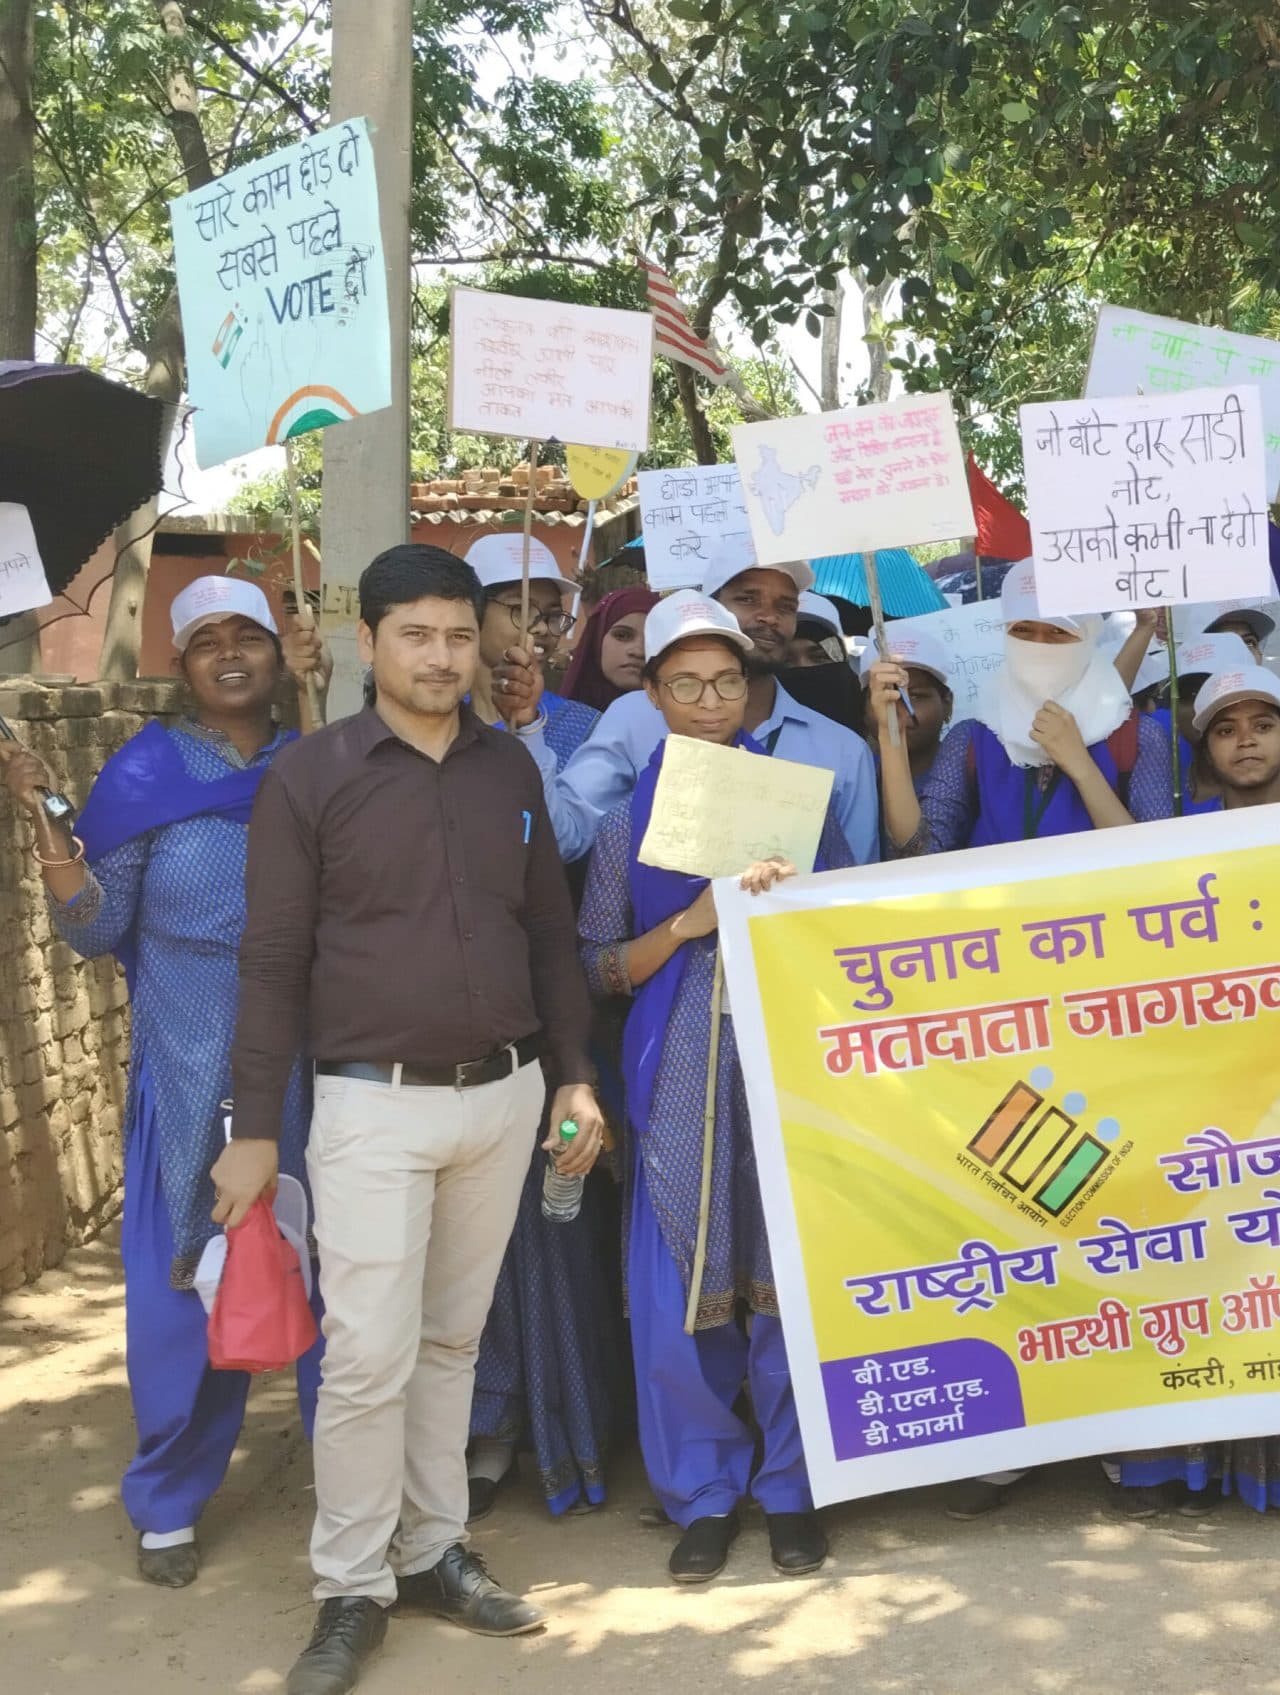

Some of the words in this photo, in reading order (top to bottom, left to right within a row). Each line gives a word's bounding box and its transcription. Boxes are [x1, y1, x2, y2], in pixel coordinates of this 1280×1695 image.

[243, 163, 291, 216] काम
[338, 125, 361, 177] दो
[216, 224, 279, 291] सबसे
[287, 201, 341, 260] पहले
[265, 270, 335, 325] VOTE
[1036, 410, 1063, 456] जो
[645, 505, 683, 528] काम
[1040, 504, 1120, 564] उसको
[1124, 507, 1185, 552] कभी
[1188, 516, 1217, 545] ना
[1115, 553, 1170, 601] वोट
[833, 928, 1000, 1010] चुनाव
[1022, 912, 1106, 965] का
[1128, 873, 1220, 948] पर्व
[820, 998, 1051, 1075] मतदाता
[956, 1152, 982, 1176] भारत
[846, 1239, 1058, 1316] राष्ट्रीय
[1079, 1218, 1206, 1276] सेवा
[1017, 1299, 1131, 1363] भारथी
[1140, 1297, 1210, 1359] ग्रुप
[862, 1403, 965, 1447] डी.फार्मा
